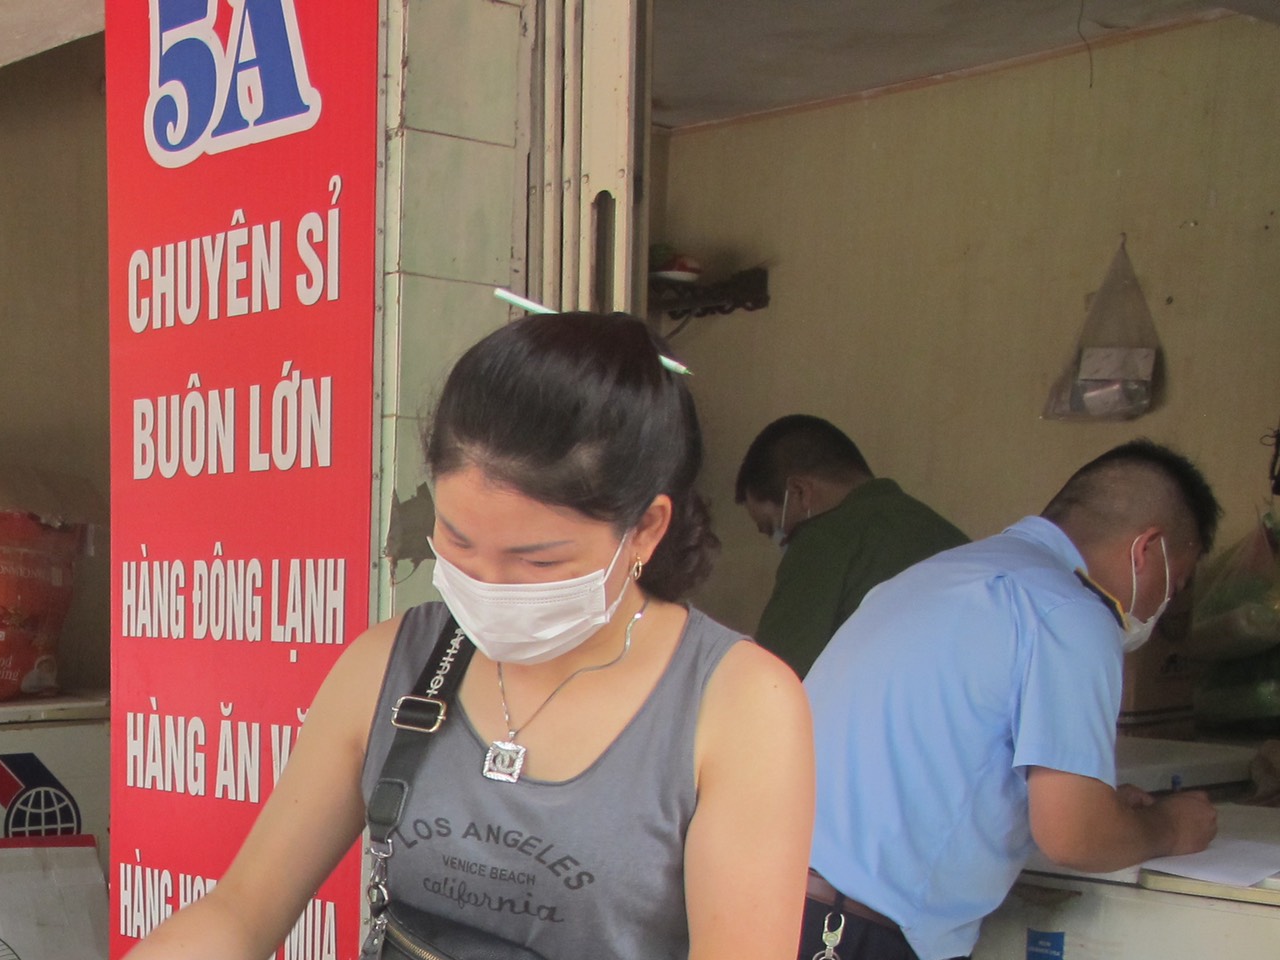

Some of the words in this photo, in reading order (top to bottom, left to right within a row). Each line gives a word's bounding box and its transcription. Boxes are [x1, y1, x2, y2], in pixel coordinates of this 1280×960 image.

[148, 0, 318, 162] 5A
[128, 208, 281, 334] CHUYÊN
[295, 174, 342, 306] SỈ
[133, 373, 235, 480] BUÔN
[249, 360, 333, 472] LỚN
[122, 544, 186, 640] HÀNG
[192, 542, 264, 643] ĐÔNG
[270, 558, 347, 663] LẠNH
[126, 696, 207, 797] HÀNG
[214, 702, 263, 804] ĂN
[119, 848, 174, 940] HÀNG
[394, 817, 453, 850] LOS
[462, 821, 596, 892] ANGELES
[423, 872, 565, 924] california
[442, 854, 486, 878] VENICE
[490, 866, 537, 887] BEACH
